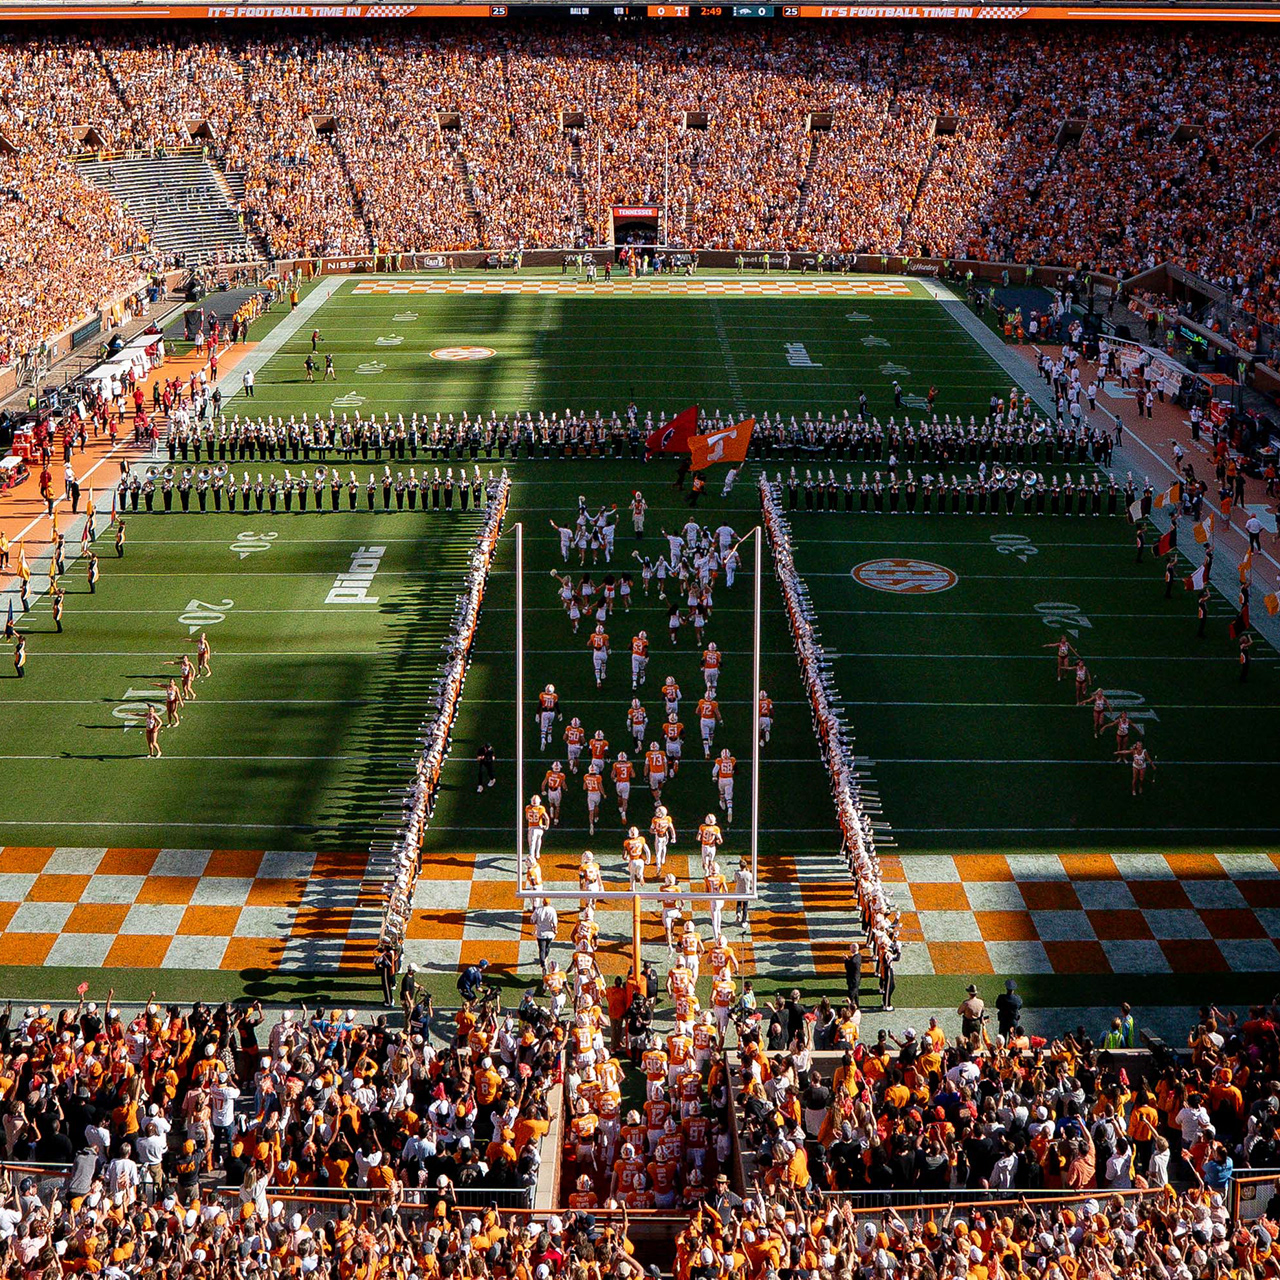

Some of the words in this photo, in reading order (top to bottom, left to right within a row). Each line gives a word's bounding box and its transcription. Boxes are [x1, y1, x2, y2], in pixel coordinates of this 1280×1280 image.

[208, 7, 235, 17] IT'S
[237, 7, 309, 17] FOOTBALL
[310, 7, 344, 17] TIME
[346, 7, 361, 17] IN
[657, 7, 665, 16] 0
[700, 7, 722, 16] 2:49
[758, 7, 766, 16] 0
[785, 7, 798, 15] 25
[821, 7, 848, 17] IT'S
[849, 7, 920, 17] FOOTBALL
[922, 7, 956, 18] TIME
[957, 7, 973, 18] IN
[327, 260, 374, 270] NISSAN
[229, 532, 278, 553] 30
[989, 534, 1039, 554] 30
[324, 546, 387, 604] pilot
[177, 598, 234, 625] 20
[1033, 601, 1093, 629] 20
